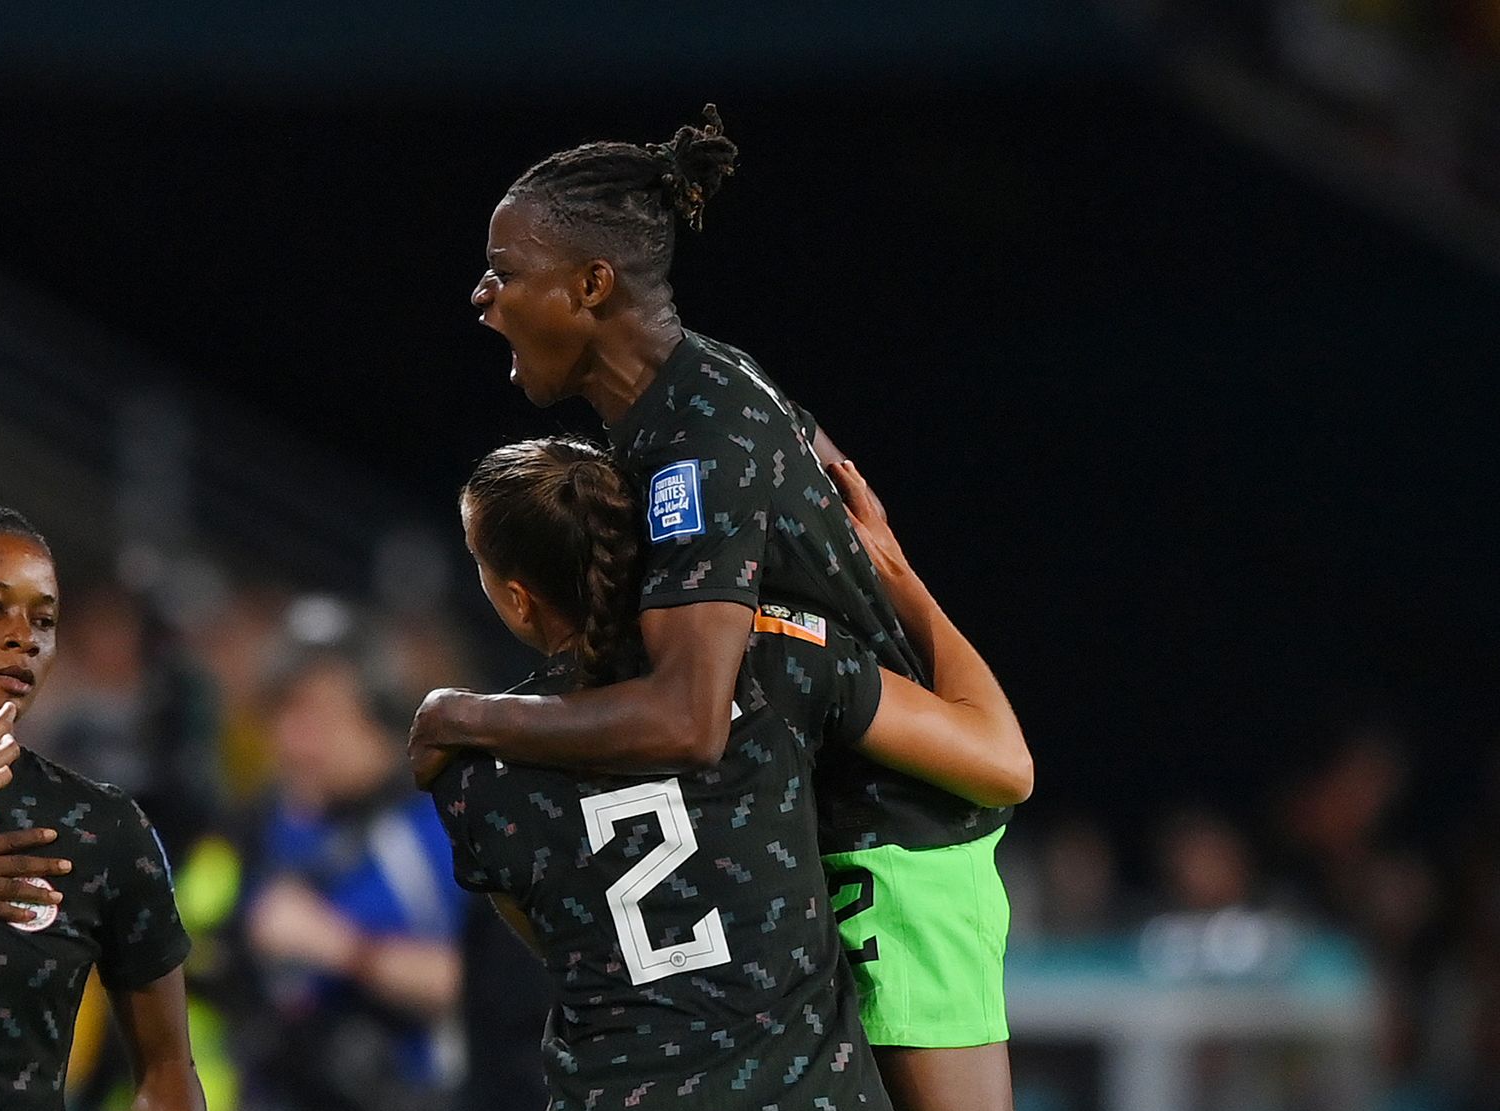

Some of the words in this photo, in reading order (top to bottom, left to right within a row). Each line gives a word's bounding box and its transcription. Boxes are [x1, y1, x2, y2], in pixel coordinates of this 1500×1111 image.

[655, 474, 685, 491] FOOTBALL
[654, 484, 687, 504] UNITES
[580, 777, 731, 985] 2
